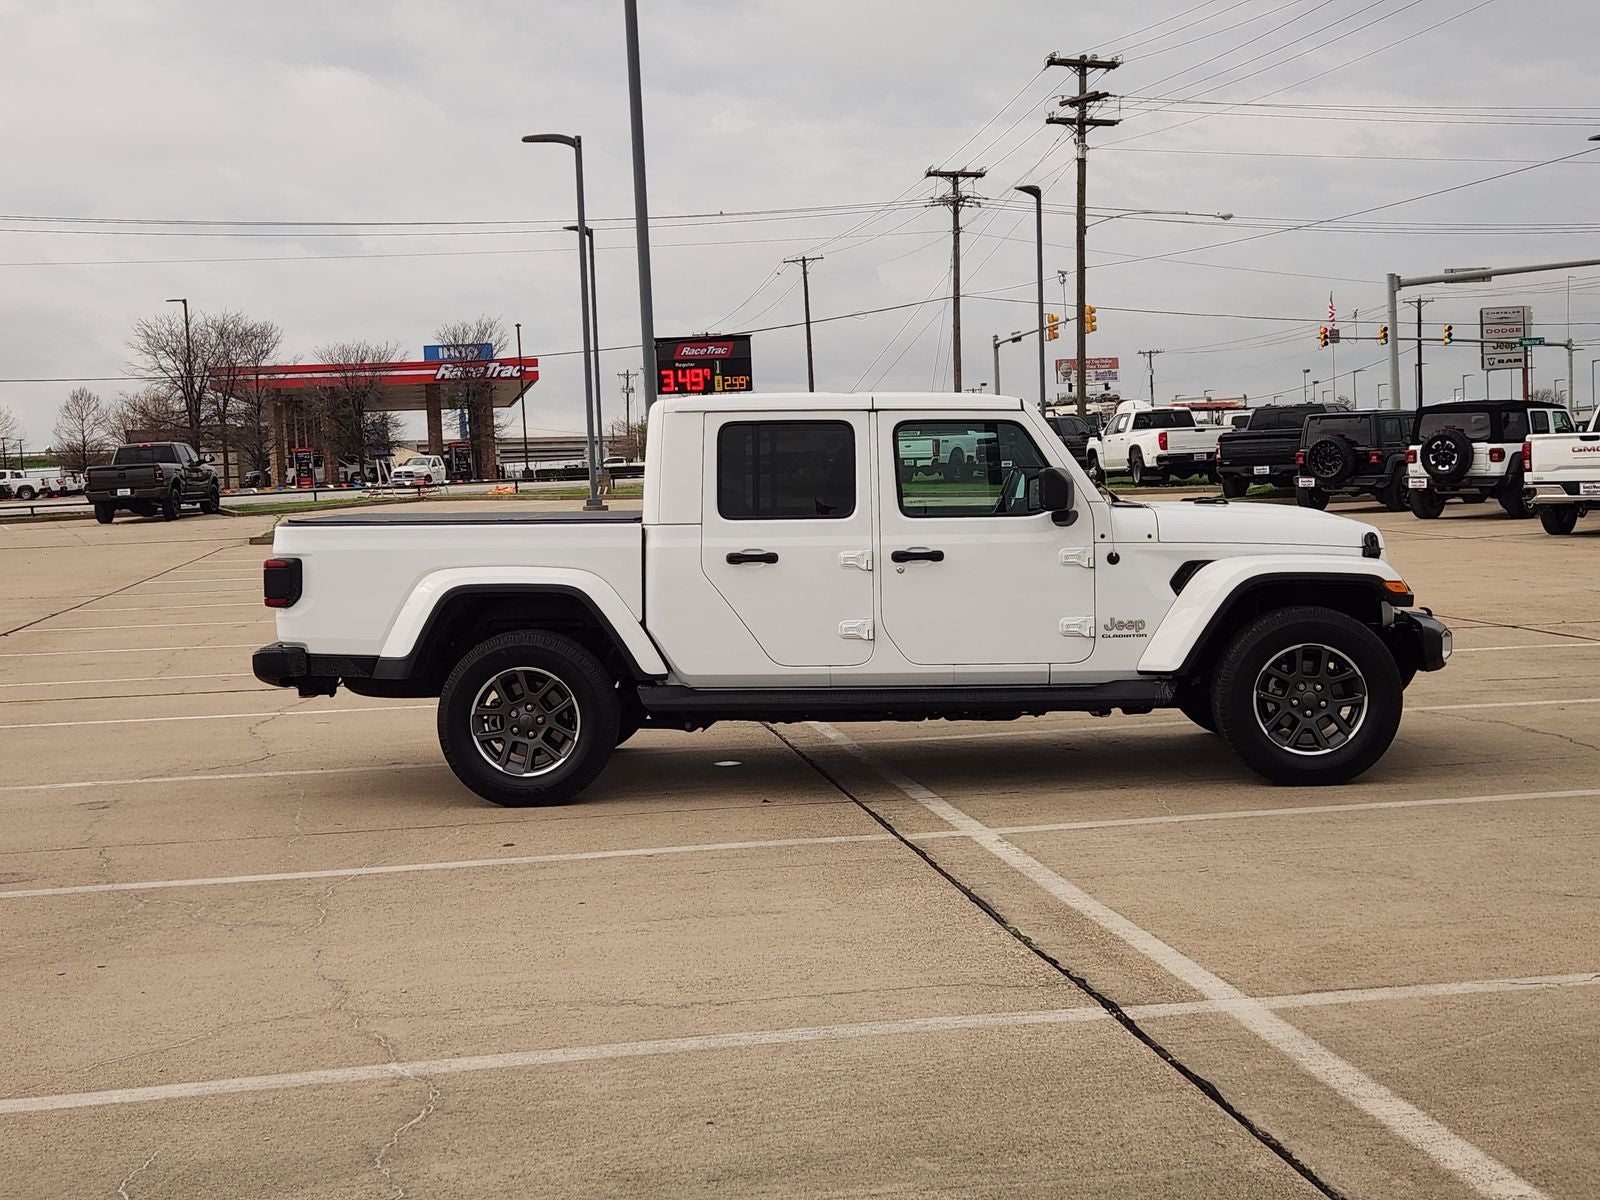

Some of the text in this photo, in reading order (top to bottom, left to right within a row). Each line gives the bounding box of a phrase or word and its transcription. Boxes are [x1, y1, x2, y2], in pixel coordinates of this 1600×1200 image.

[680, 346, 728, 356] RaceTrac
[1492, 341, 1517, 351] Jeep
[435, 362, 525, 380] RaceTrac
[1103, 616, 1146, 633] Jeep
